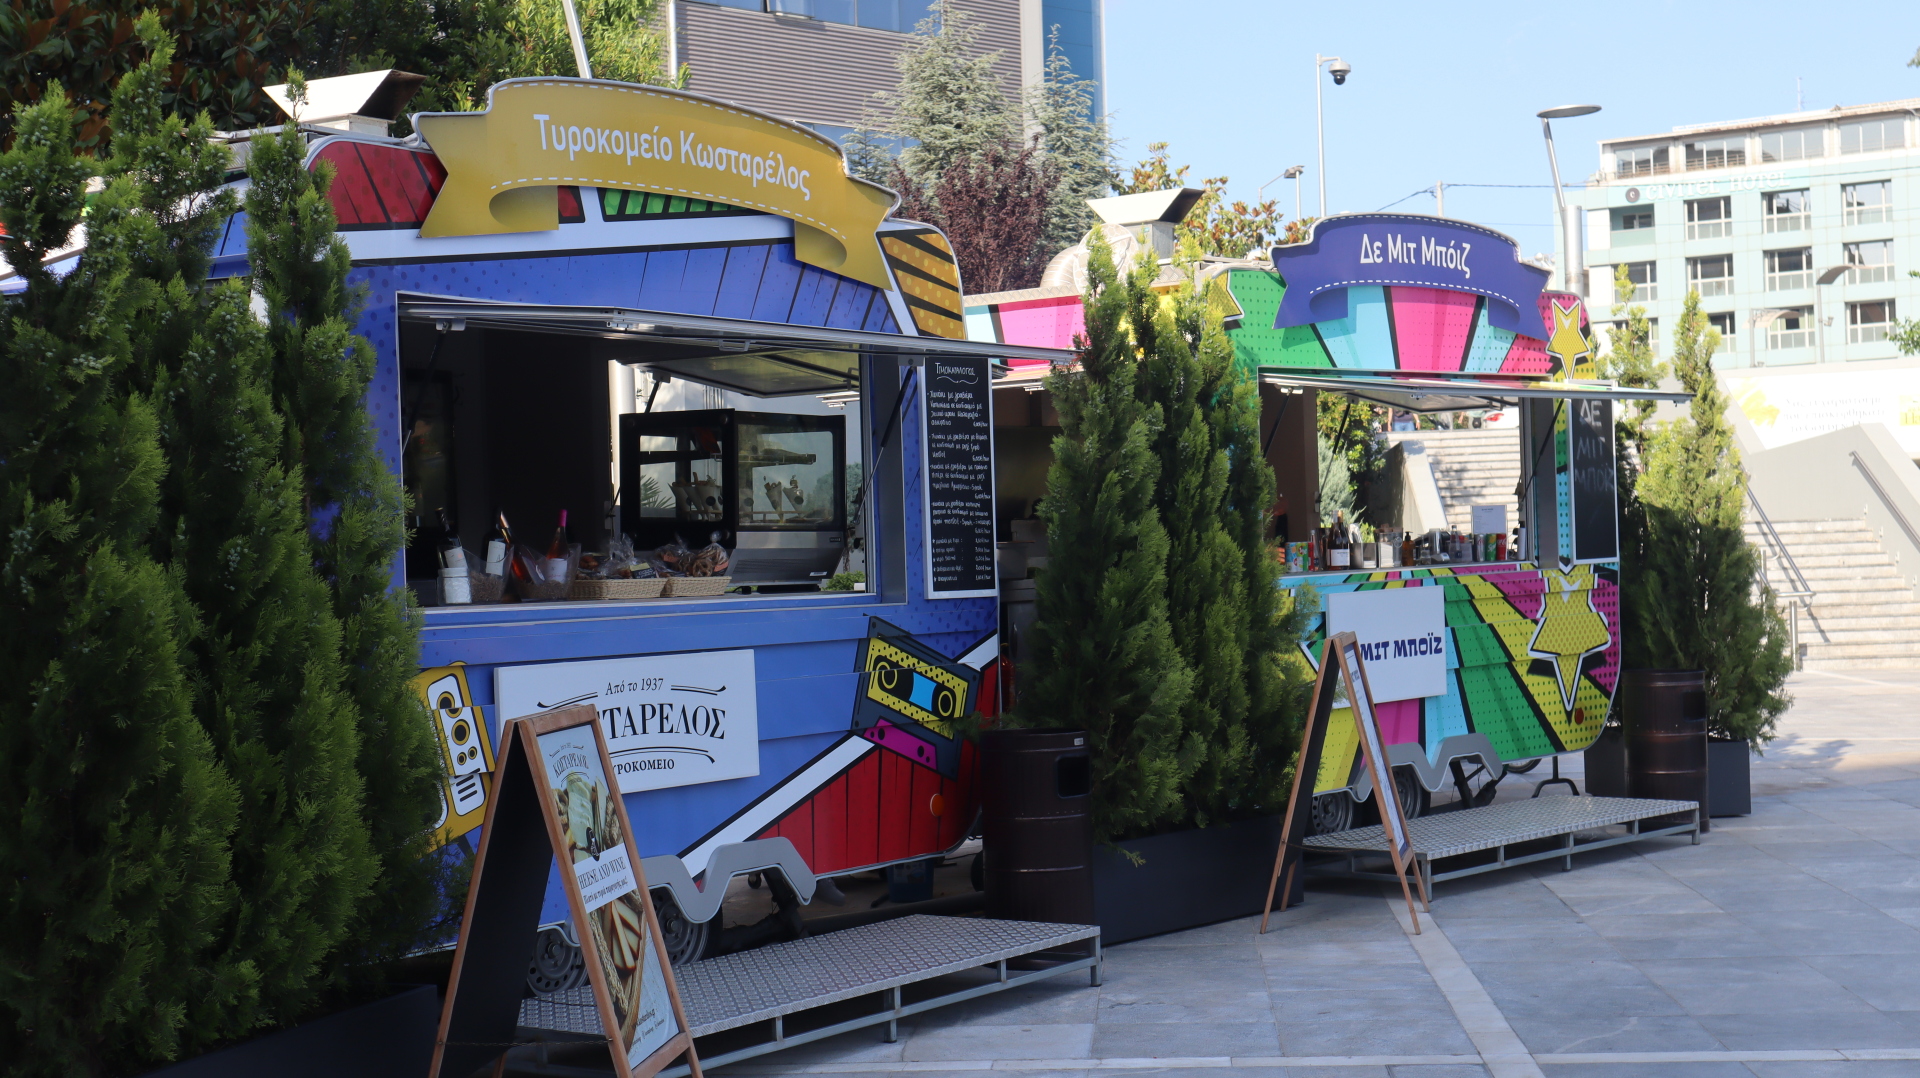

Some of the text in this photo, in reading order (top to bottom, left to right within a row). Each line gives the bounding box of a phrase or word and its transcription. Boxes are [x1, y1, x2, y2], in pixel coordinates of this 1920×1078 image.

[533, 113, 811, 201] Τυροκομείο Κωσταρέλος
[1359, 233, 1471, 280] Δε Μιτ Μπόιζ
[1579, 398, 1602, 427] ΔΕ
[1360, 632, 1442, 661] ΜΙΤ ΜΠΟΪΖ
[605, 678, 664, 696] Από το 1937
[596, 703, 726, 740] ΤΑΡΕΛΟΣ
[598, 863, 611, 880] AND
[608, 856, 627, 874] WINE
